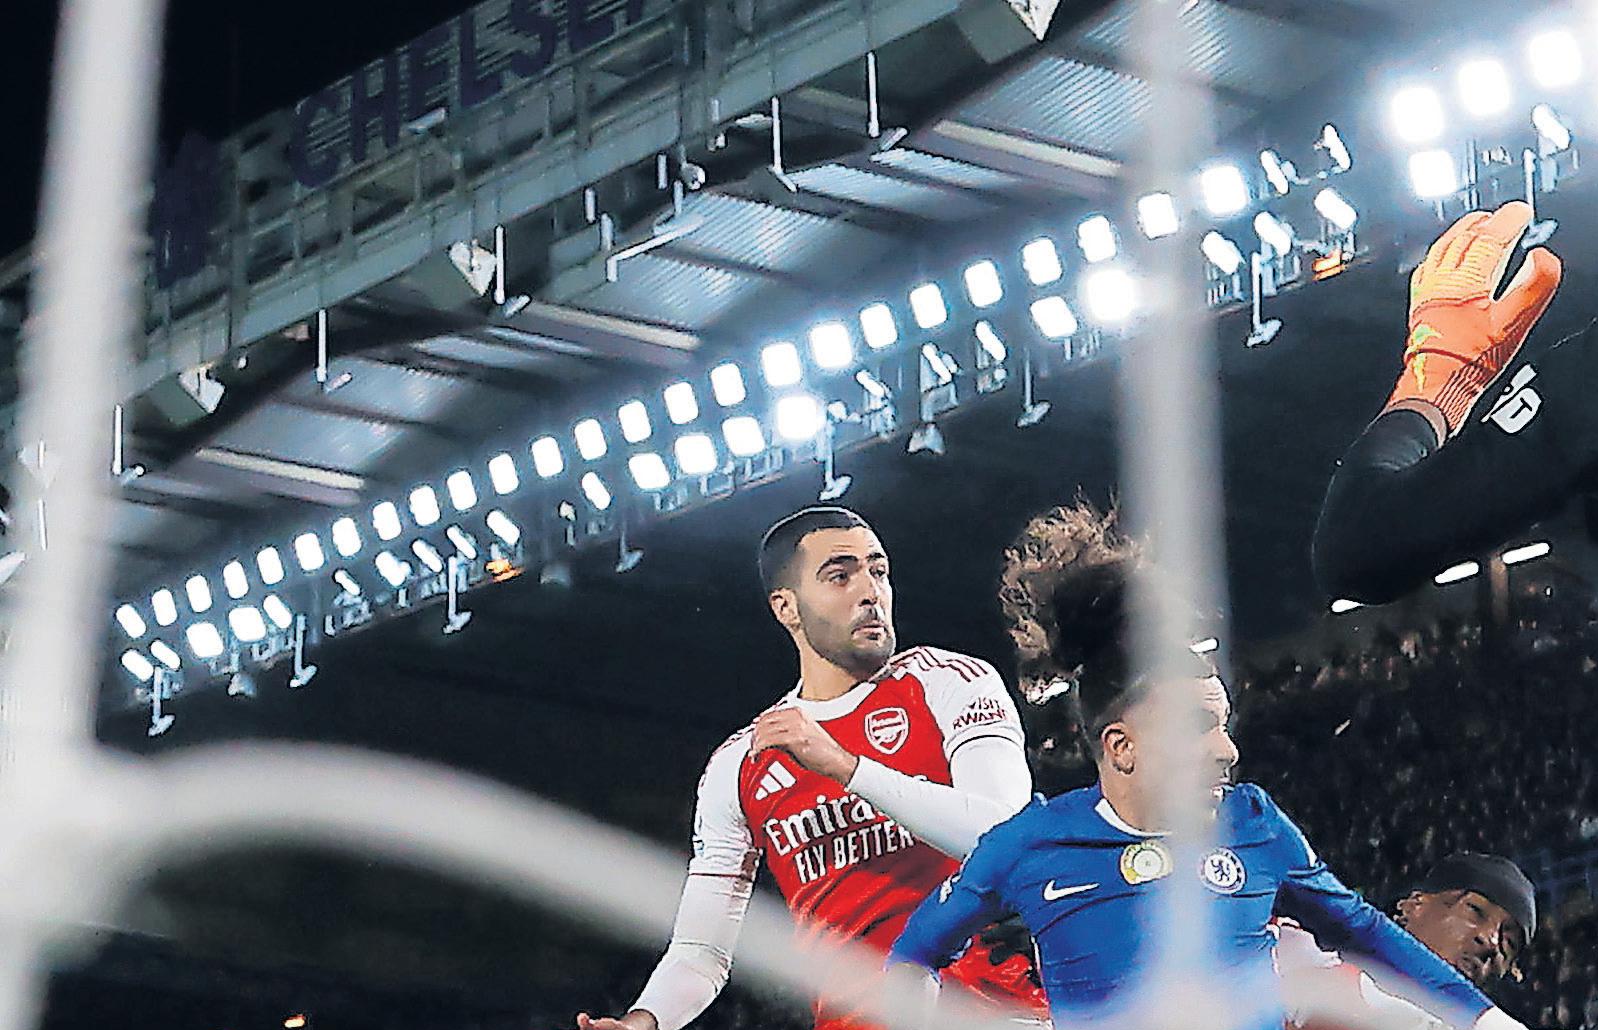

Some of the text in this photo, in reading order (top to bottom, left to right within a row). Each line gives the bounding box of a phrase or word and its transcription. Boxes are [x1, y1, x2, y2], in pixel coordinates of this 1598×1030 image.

[287, 0, 645, 187] CHELSE
[765, 793, 884, 856] Emira
[794, 844, 827, 884] FLY
